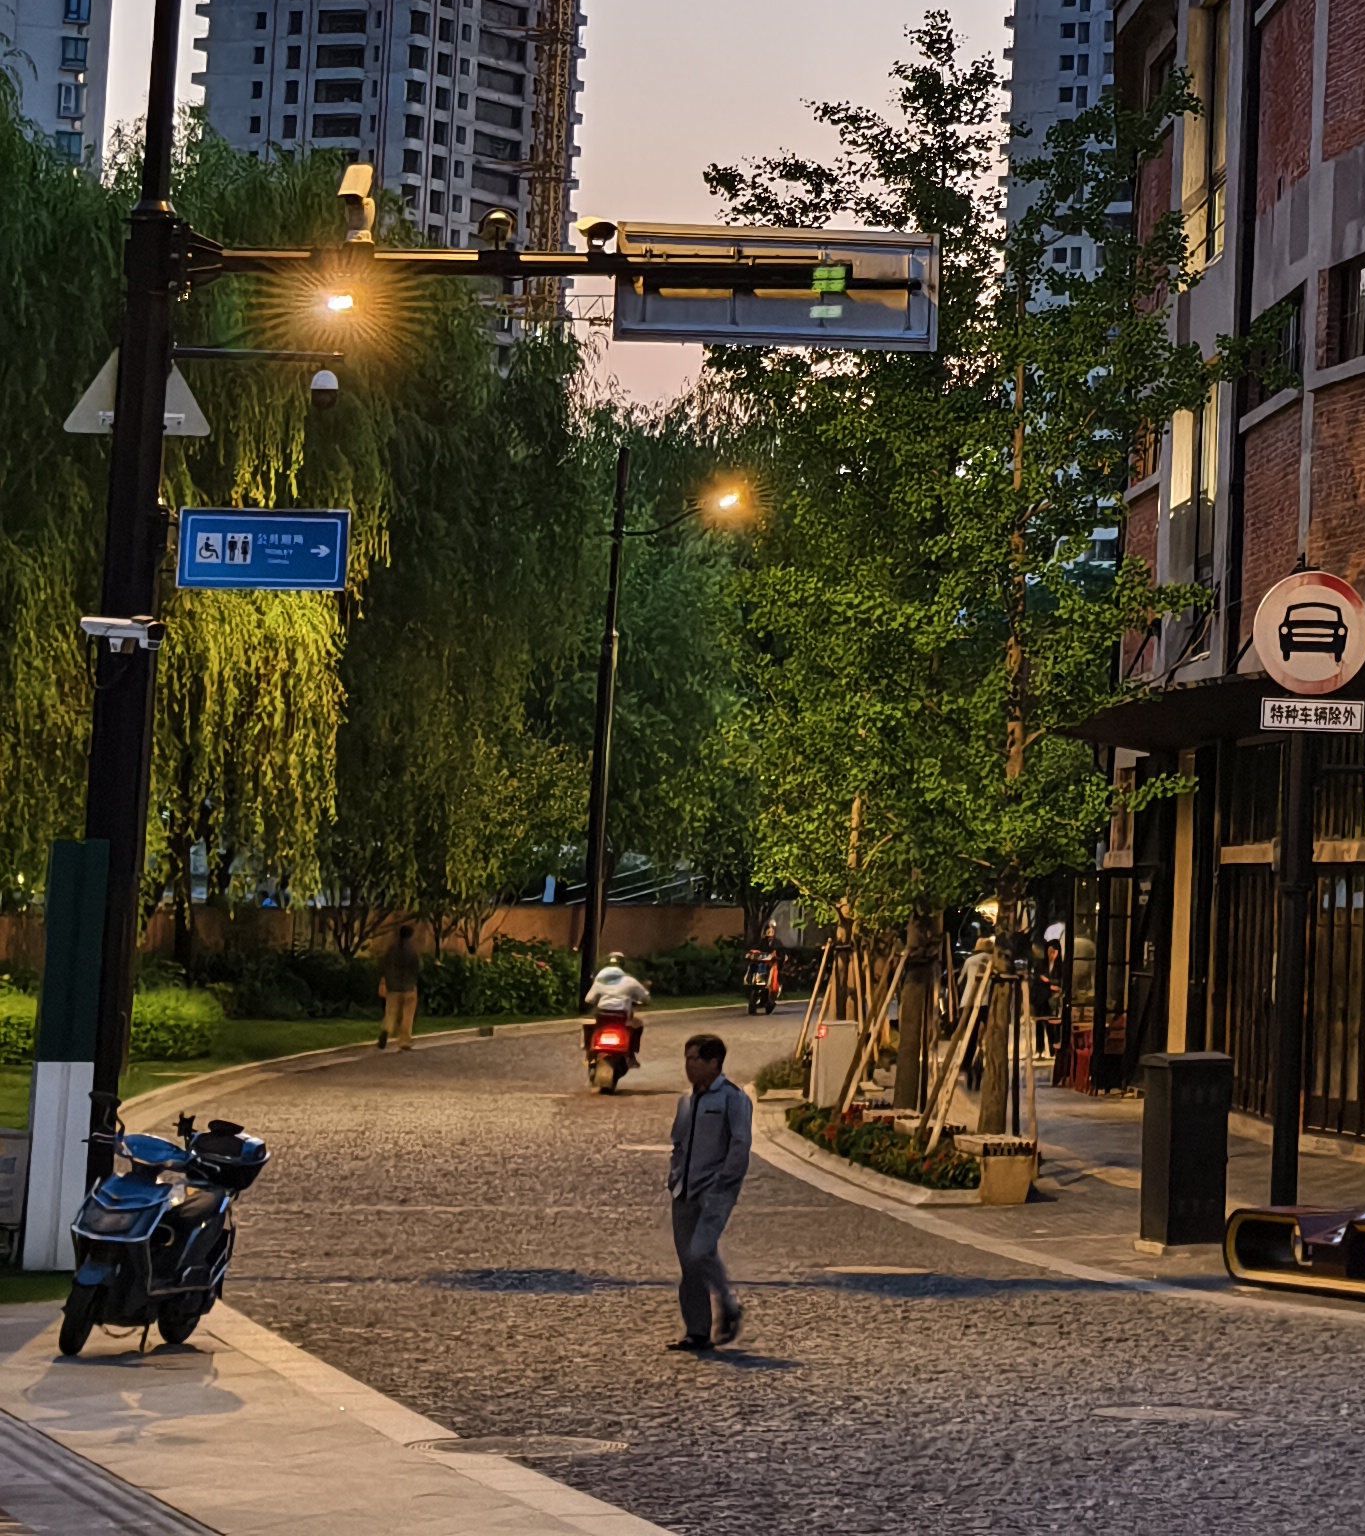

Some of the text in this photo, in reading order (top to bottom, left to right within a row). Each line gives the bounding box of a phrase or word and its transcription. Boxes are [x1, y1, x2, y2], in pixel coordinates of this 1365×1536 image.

[1270, 703, 1356, 726] 特种车辆除外
